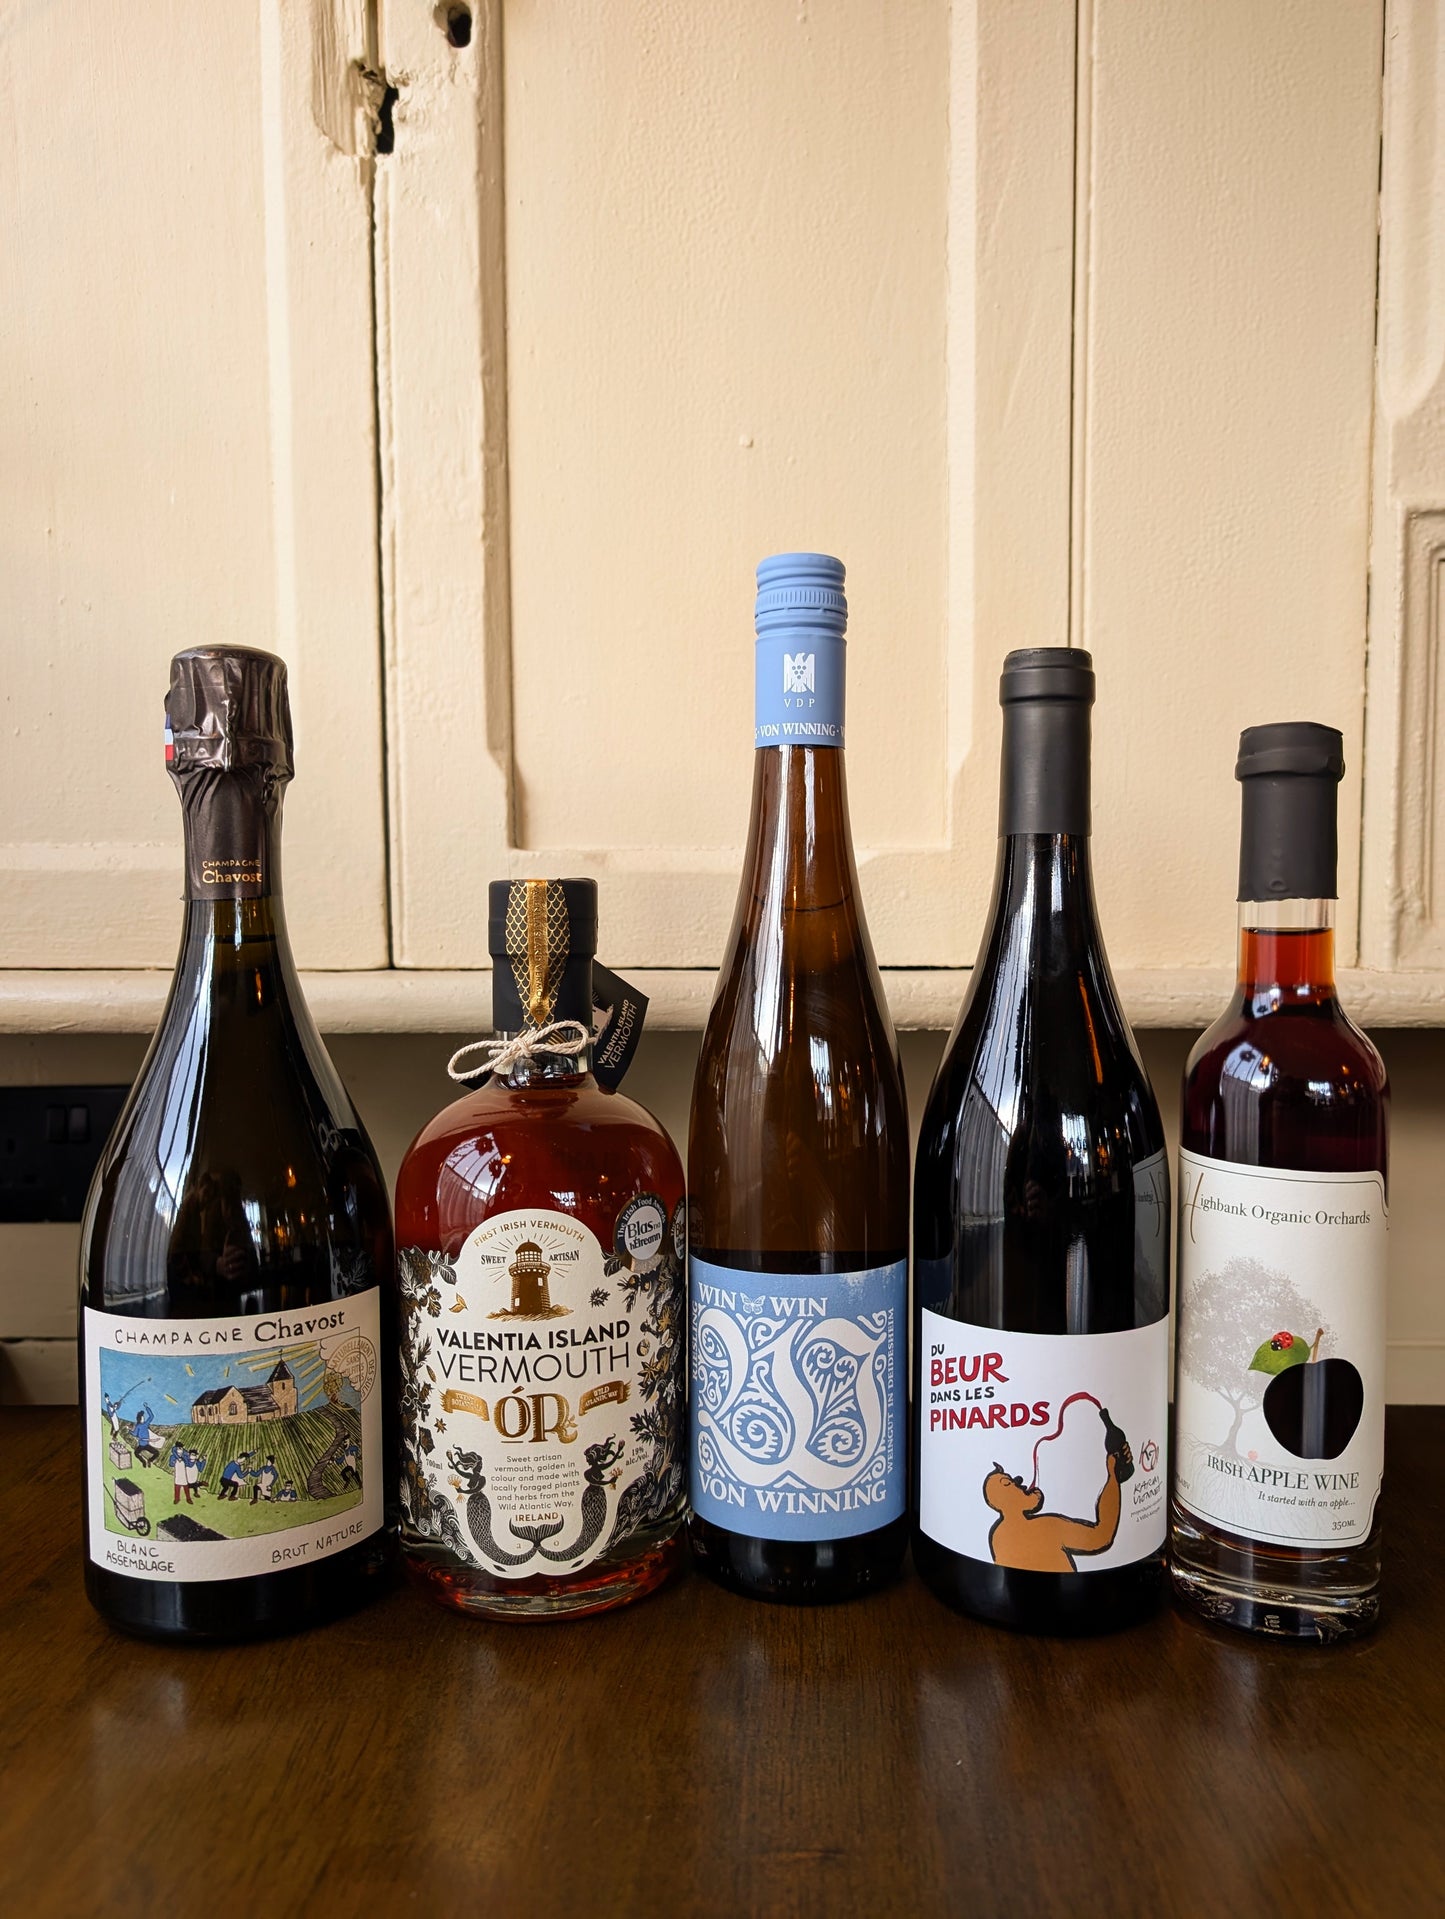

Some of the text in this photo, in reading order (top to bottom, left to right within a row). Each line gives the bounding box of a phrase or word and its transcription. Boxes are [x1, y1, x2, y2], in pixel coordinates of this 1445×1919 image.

[760, 723, 780, 738] VON
[782, 721, 836, 737] WINNING
[202, 859, 262, 869] CHAMPAGNE
[202, 869, 263, 884] Chavost
[598, 999, 630, 1065] VALENTIA ISLAND
[604, 1002, 638, 1069] VERMOUTH
[617, 1222, 627, 1240] The
[622, 1204, 637, 1222] Irish
[637, 1197, 653, 1207] Food
[1251, 1204, 1312, 1225] Organic
[1315, 1210, 1371, 1225] Orchards
[473, 1220, 585, 1247] FIRST IRISH VERMOUTH
[627, 1220, 654, 1239] Blas
[481, 1249, 580, 1265] SWEET ARTISAN
[698, 1282, 828, 1317] WIN WIN
[254, 1309, 346, 1342] Chavost
[114, 1328, 243, 1346] CHAMPAGNE
[437, 1320, 630, 1351] VALENTIA ISLAND
[931, 1344, 945, 1357] DU
[437, 1342, 630, 1384] VERMOUTH
[930, 1352, 1010, 1387] BEUR
[585, 1392, 608, 1407] ATLANTIC
[593, 1385, 610, 1397] WILD
[930, 1386, 995, 1403] DANS LES
[887, 1393, 894, 1408] IN
[493, 1386, 579, 1444] ÓR
[930, 1401, 1050, 1432] PINARDS
[506, 1454, 562, 1463] Sweet artisan
[537, 1462, 565, 1472] golden
[518, 1474, 534, 1482] and
[536, 1472, 560, 1480] made
[562, 1469, 580, 1478] with
[1207, 1454, 1360, 1491] IRISH APPLE WINE
[491, 1480, 580, 1492] locally foraged plants
[698, 1470, 887, 1514] VON WINNING
[514, 1493, 537, 1501] herbs
[519, 1502, 552, 1510] Atlantic
[554, 1500, 574, 1508] Way.
[1258, 1490, 1266, 1501] It
[1266, 1494, 1297, 1506] started
[1297, 1496, 1316, 1507] with
[515, 1512, 559, 1522] IRELAND
[116, 1539, 159, 1558] BLANC
[271, 1520, 364, 1564] BRUT NATURE
[105, 1551, 176, 1574] ASSEMBLAGE
